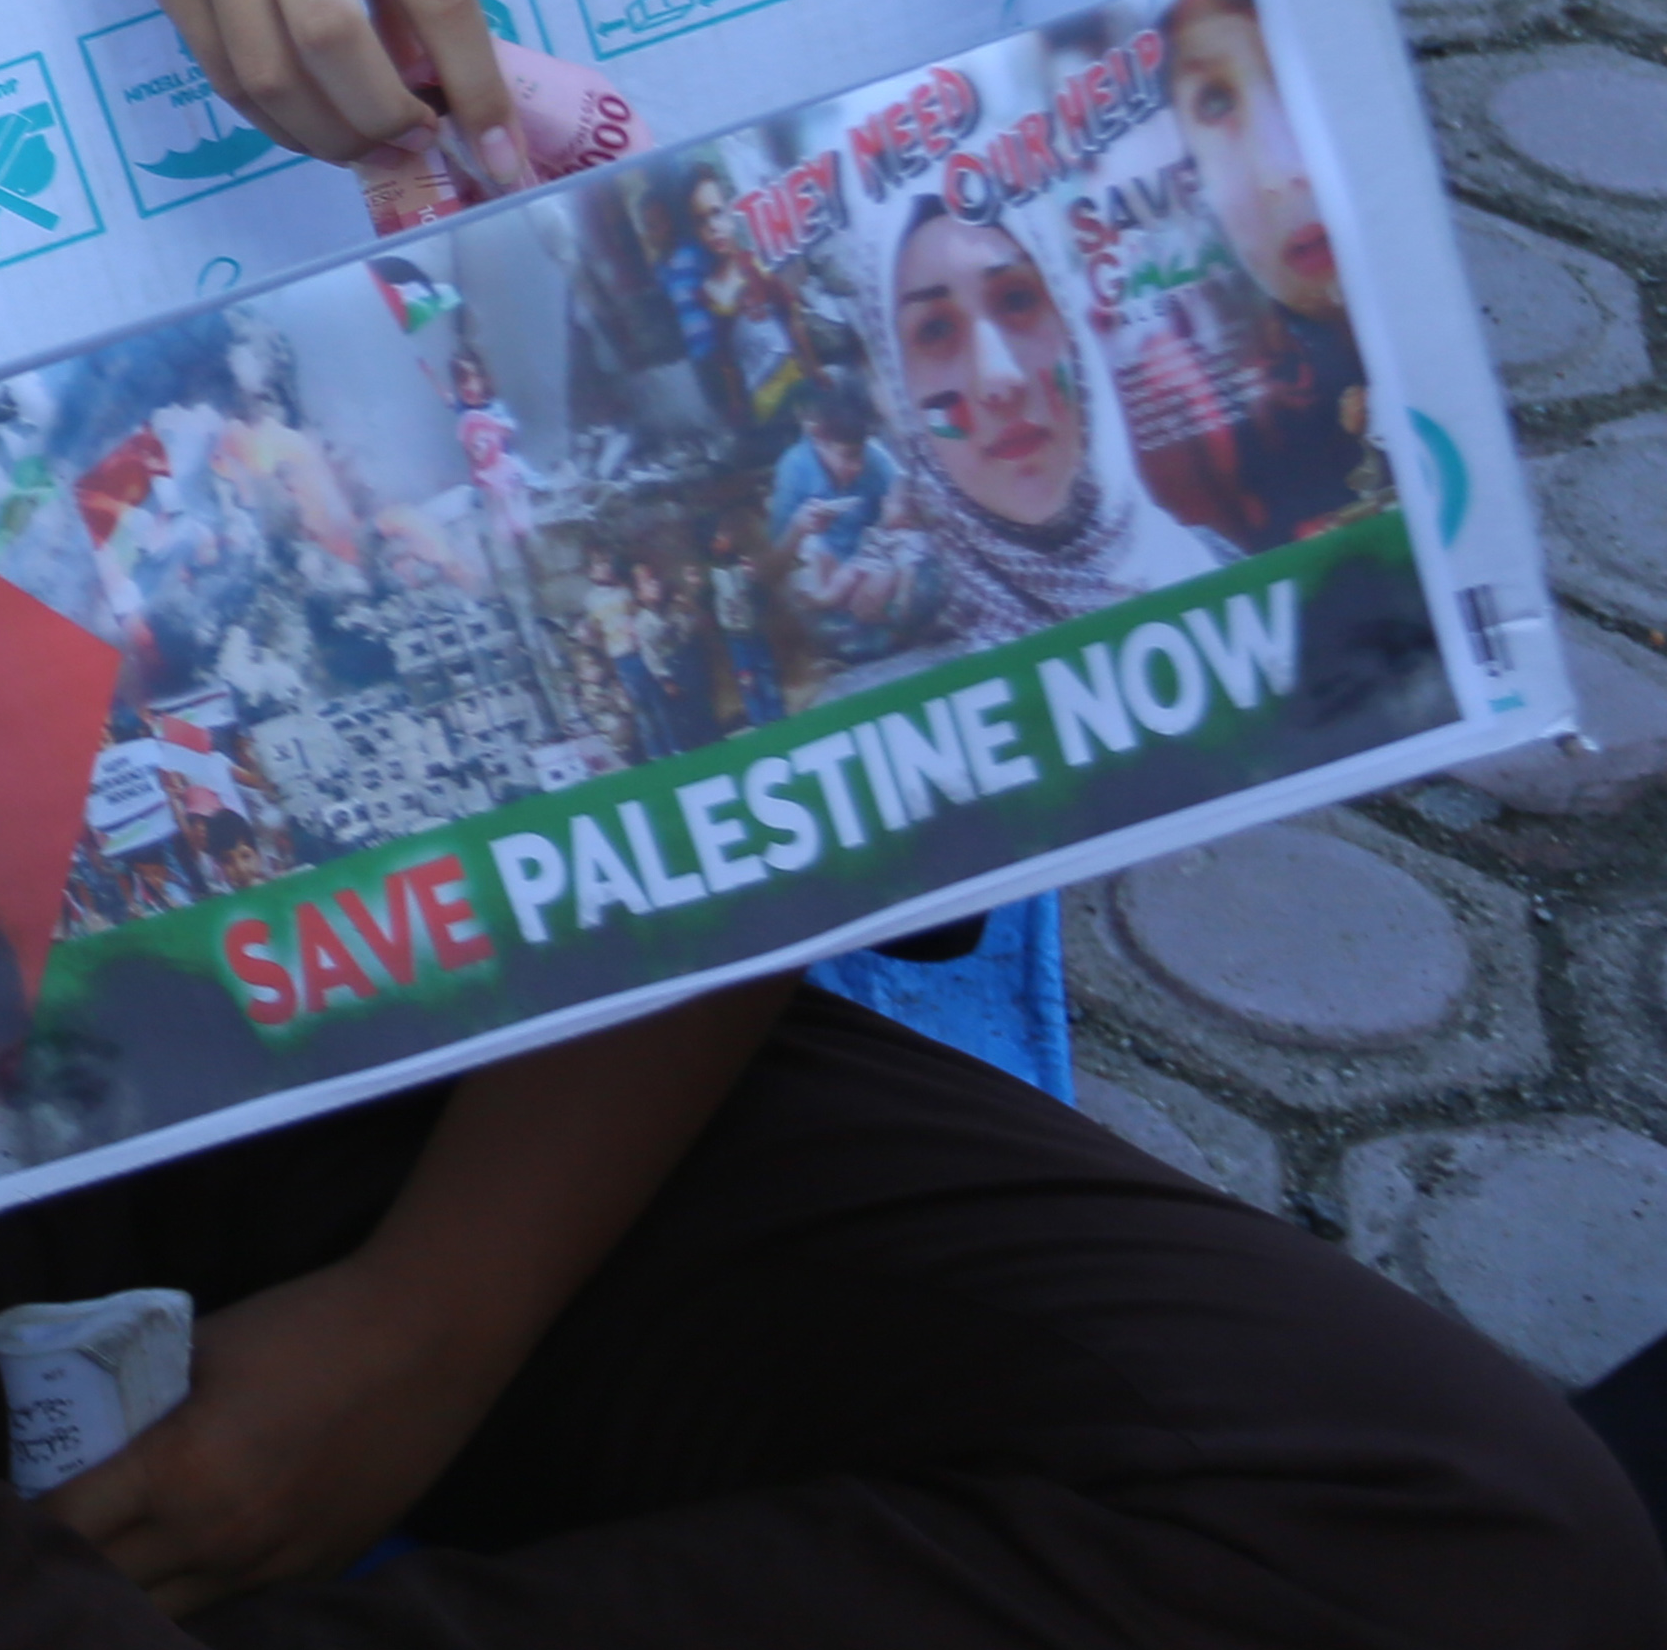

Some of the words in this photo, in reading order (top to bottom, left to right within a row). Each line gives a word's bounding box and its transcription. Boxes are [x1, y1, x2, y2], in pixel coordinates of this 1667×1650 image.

[733, 150, 851, 268] THEY
[847, 66, 982, 204] NEED
[943, 111, 1067, 226] OUR
[1055, 28, 1167, 160] HELP
[223, 854, 493, 1026] SAVE
[488, 676, 1040, 944] PALESTINE
[1037, 580, 1303, 767] NOW
